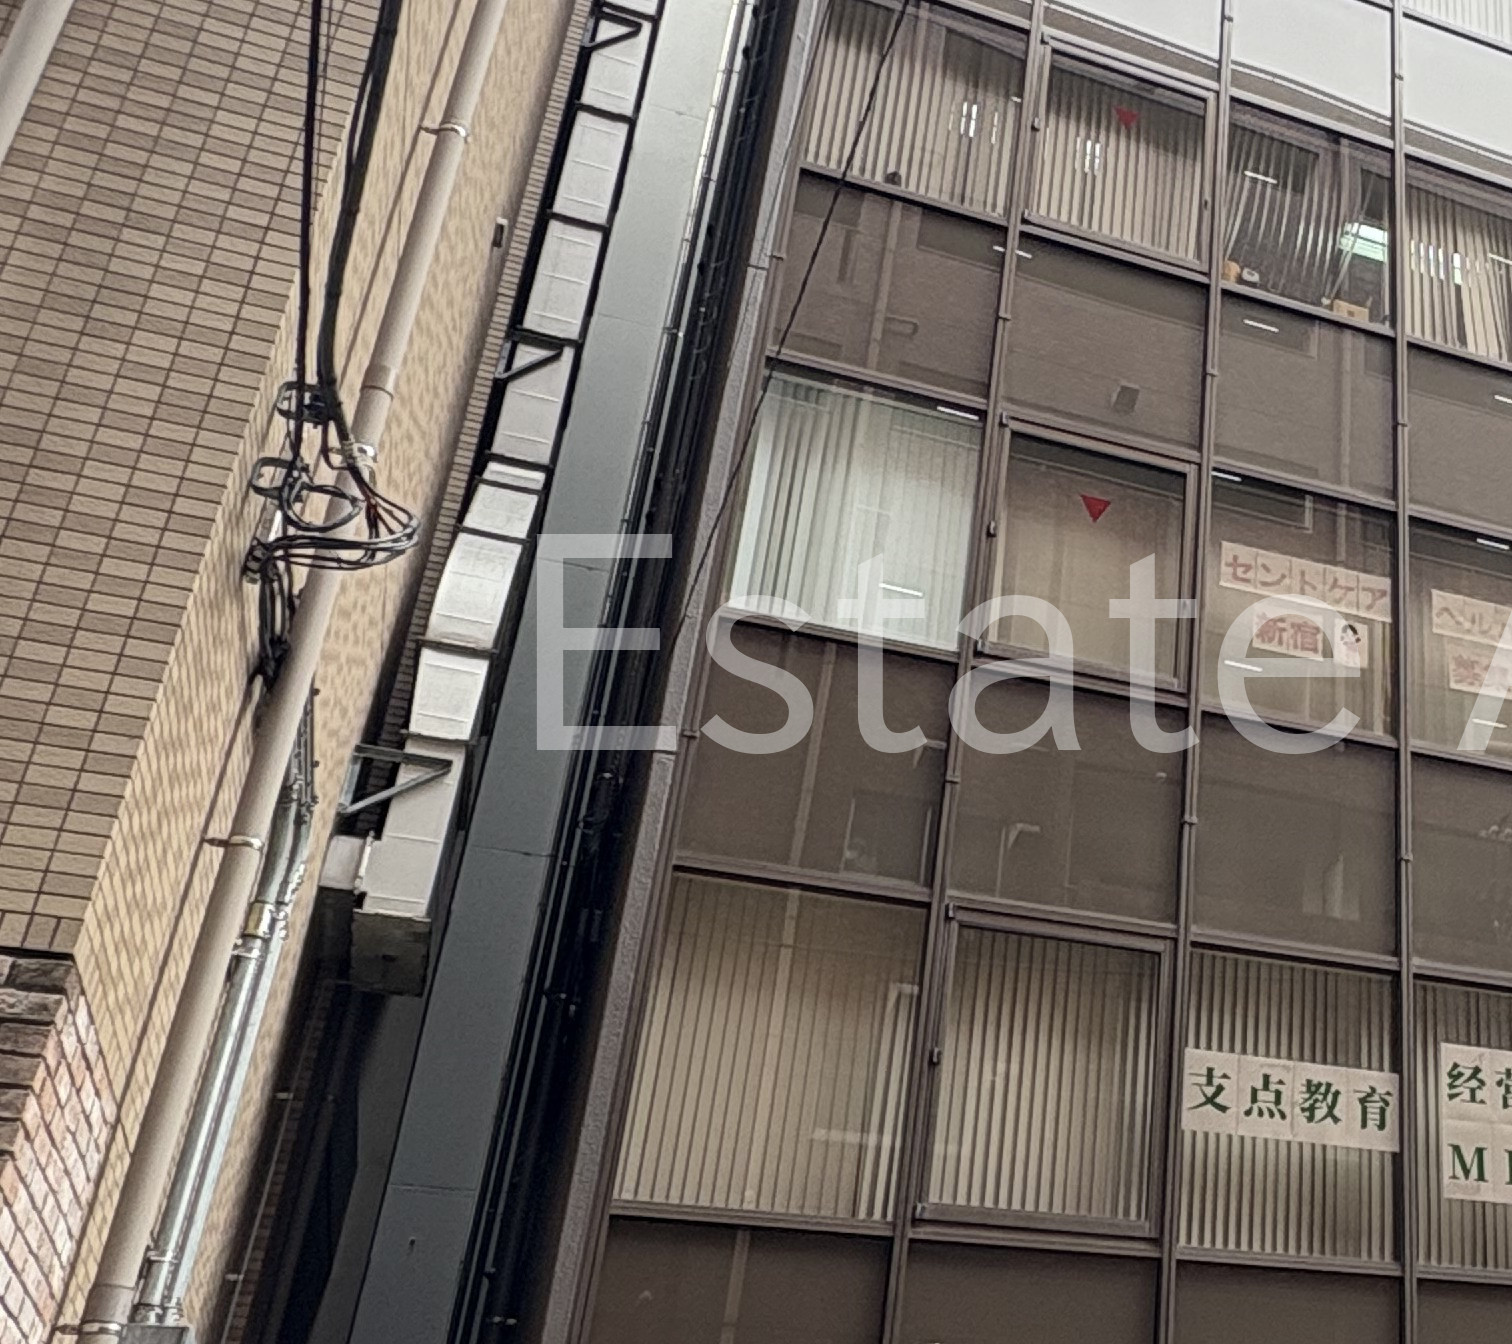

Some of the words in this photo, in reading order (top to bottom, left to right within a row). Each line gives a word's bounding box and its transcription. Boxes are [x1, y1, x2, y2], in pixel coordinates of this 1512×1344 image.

[1224, 553, 1389, 611] セントケア
[1254, 611, 1322, 655] 新宿
[1186, 1066, 1394, 1132] 支点教育
